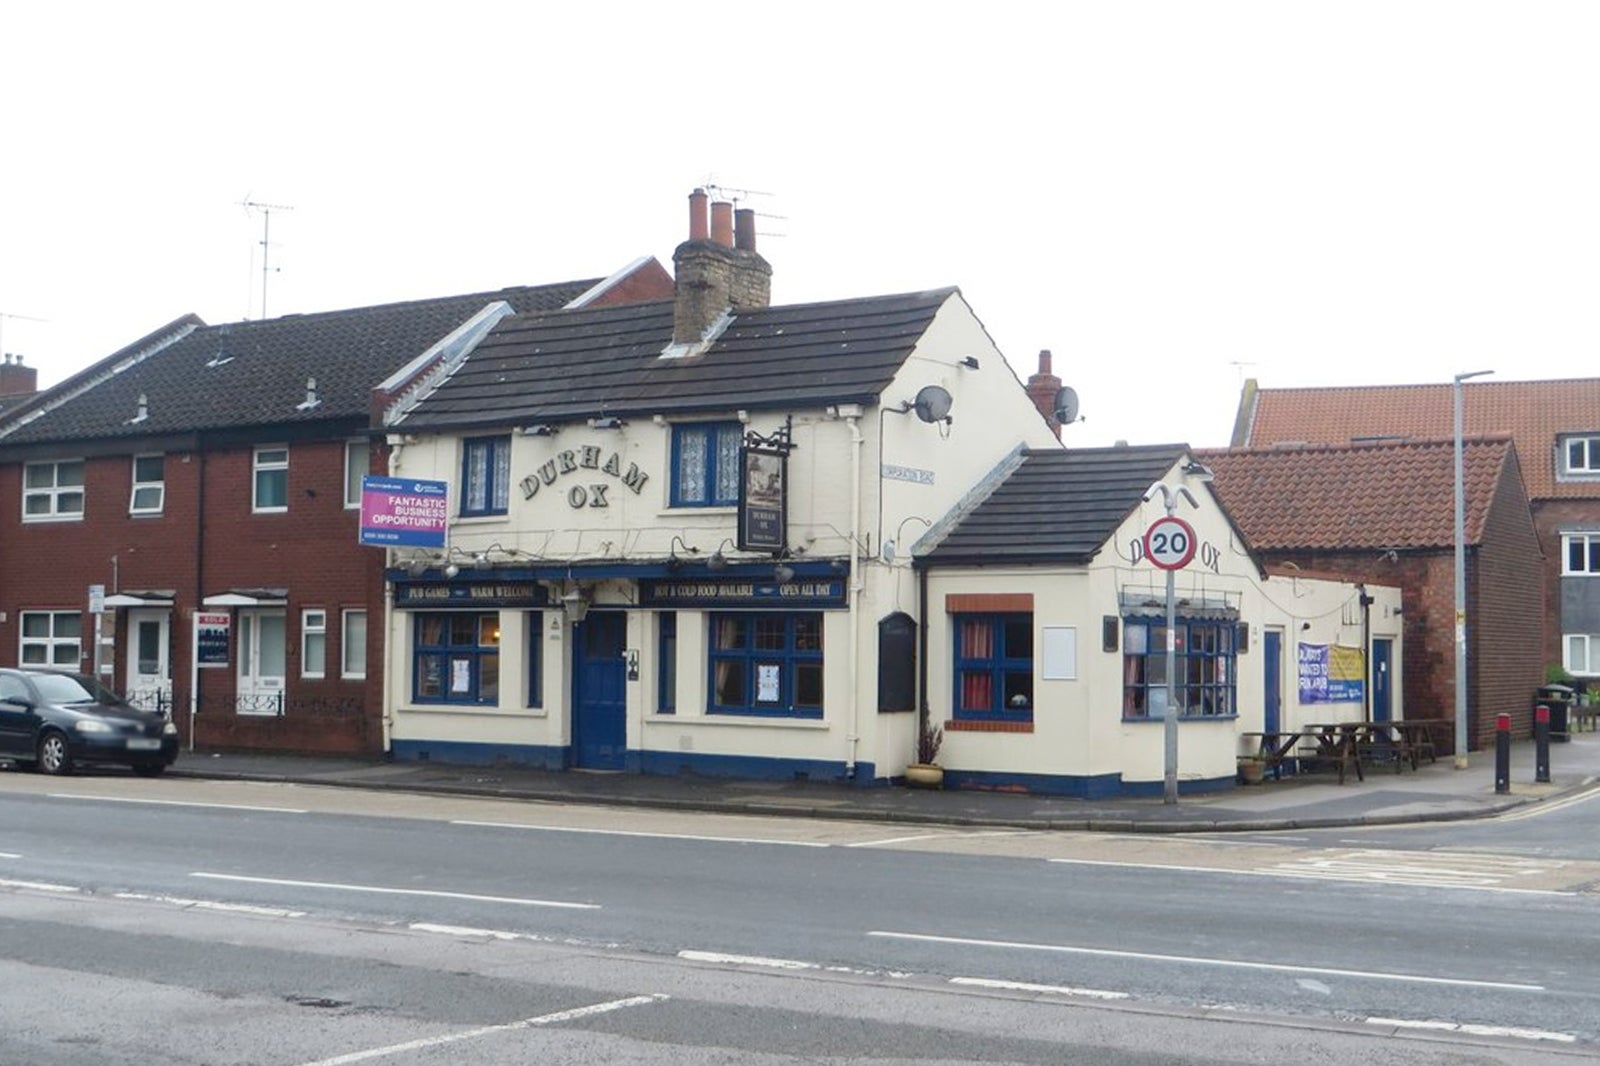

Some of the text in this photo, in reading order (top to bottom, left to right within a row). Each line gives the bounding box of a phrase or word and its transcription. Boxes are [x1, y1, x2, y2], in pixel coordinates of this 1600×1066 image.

[519, 445, 650, 501] DURHAM
[388, 496, 446, 508] FANTASTIC
[568, 484, 609, 509] OX
[395, 506, 446, 518] BUSINESS
[372, 514, 446, 528] OPPORTUNITY
[1153, 532, 1187, 554] 20
[1201, 541, 1221, 575] OX
[470, 585, 494, 598] WARM
[697, 584, 718, 597] FOOD
[779, 584, 800, 597] OPEN
